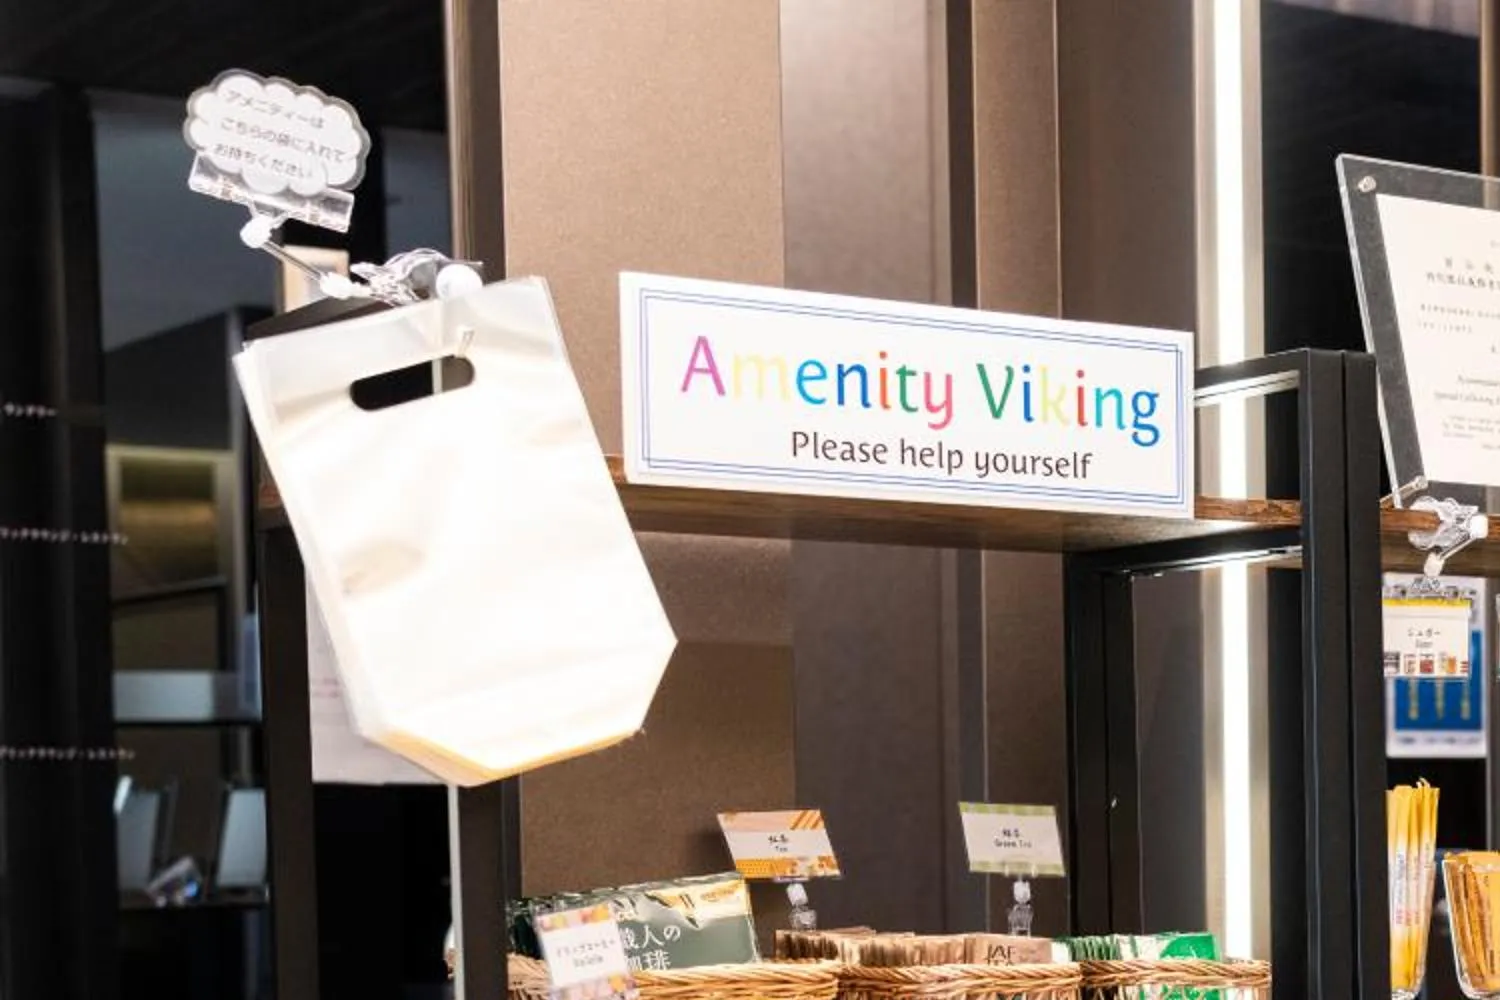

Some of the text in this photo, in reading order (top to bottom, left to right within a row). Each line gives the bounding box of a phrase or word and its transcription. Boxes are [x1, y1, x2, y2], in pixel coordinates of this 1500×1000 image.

[681, 335, 1161, 447] Amenity Viking
[791, 430, 1093, 480] Please help yourself
